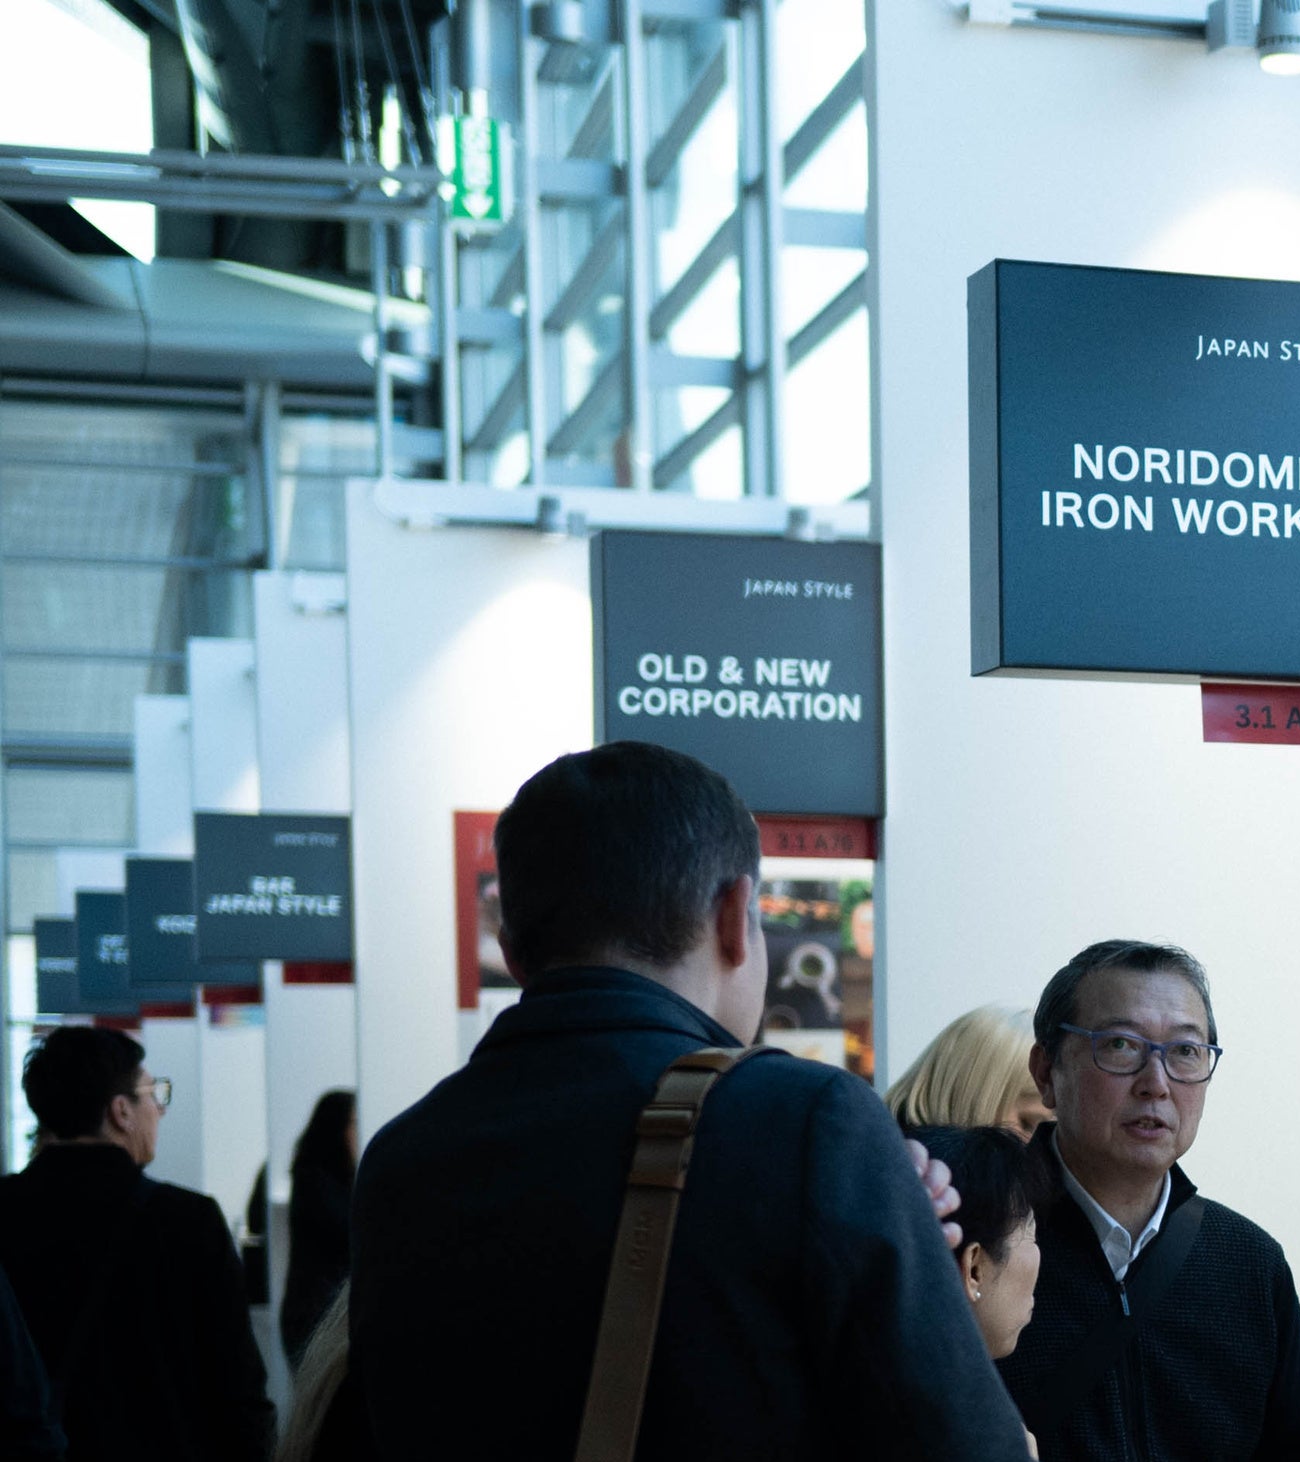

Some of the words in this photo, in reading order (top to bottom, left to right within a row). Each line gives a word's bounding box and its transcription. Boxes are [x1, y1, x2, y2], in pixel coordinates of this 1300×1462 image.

[1195, 335, 1269, 361] JAPAN
[1041, 490, 1153, 532] IRON
[743, 578, 798, 598] JAPAN
[803, 580, 854, 600] STYLE
[638, 652, 708, 683] OLD
[718, 655, 745, 686] &
[755, 657, 831, 687] NEW
[618, 686, 863, 722] CORPORATION
[1234, 704, 1276, 729] 3.1
